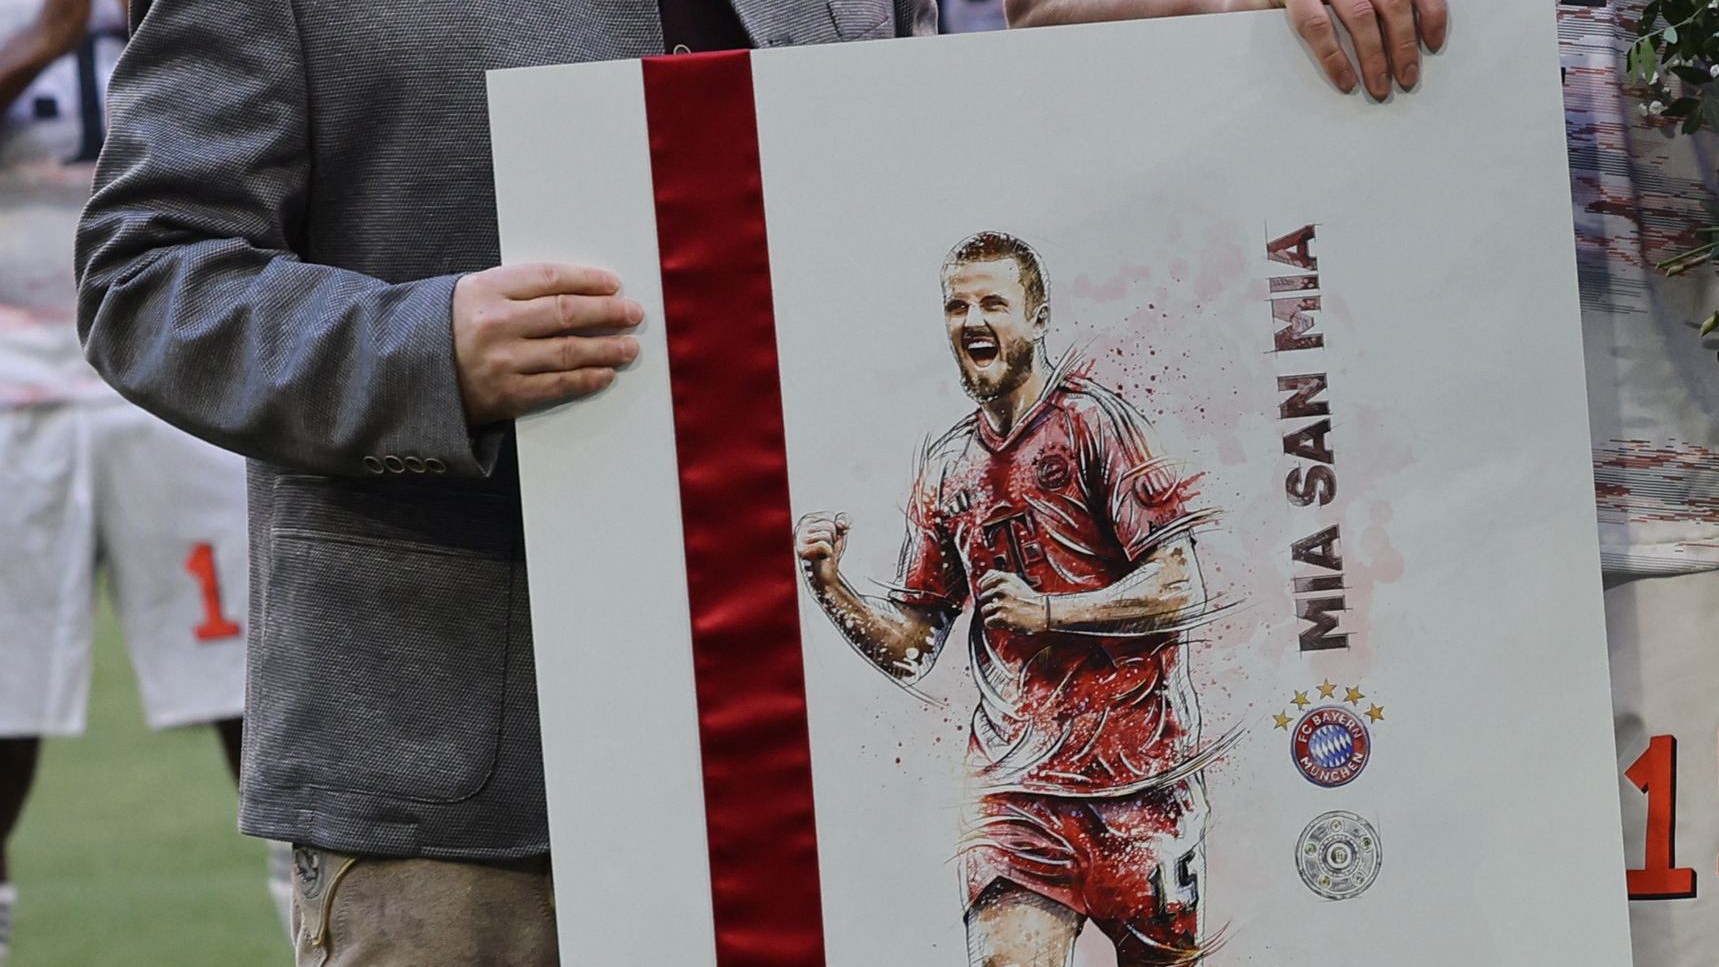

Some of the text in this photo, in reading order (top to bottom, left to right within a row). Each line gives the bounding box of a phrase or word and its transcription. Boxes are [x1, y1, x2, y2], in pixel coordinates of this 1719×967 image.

[1267, 223, 1350, 653] MIA SAN MIA
[1298, 712, 1362, 744] FC BAYERN
